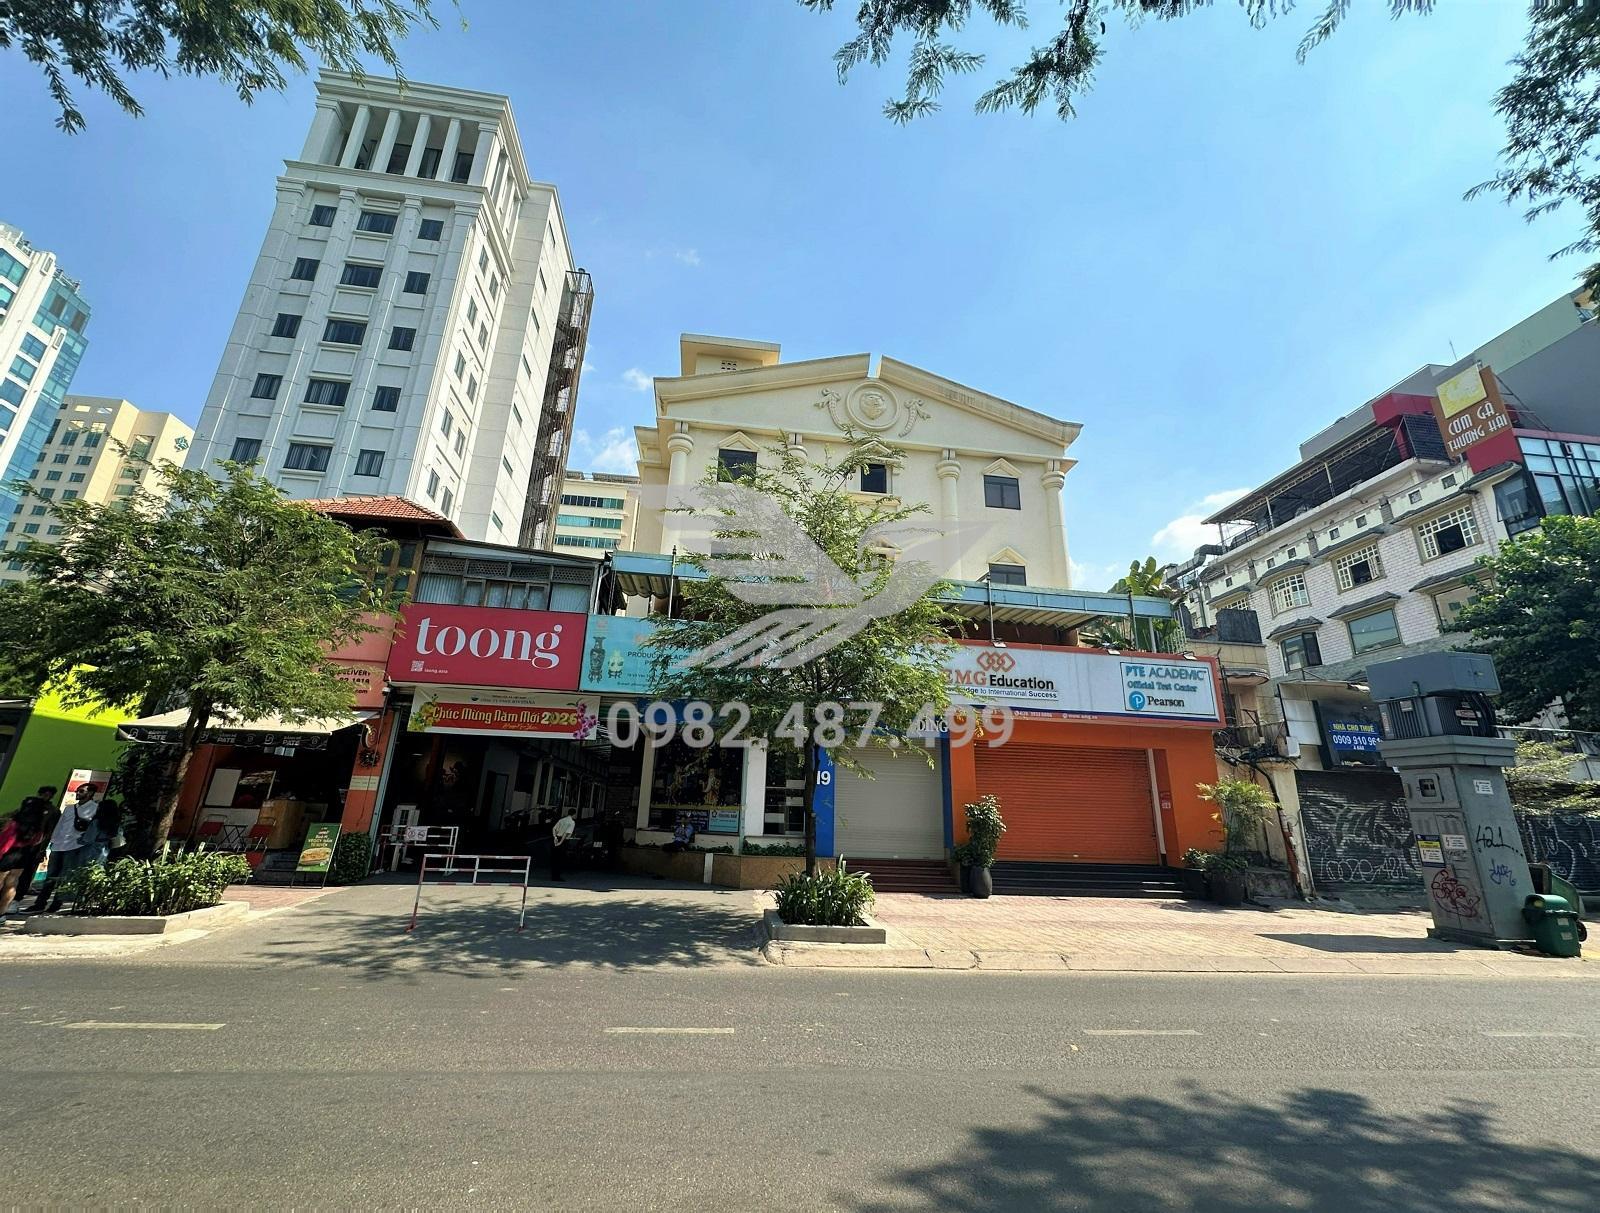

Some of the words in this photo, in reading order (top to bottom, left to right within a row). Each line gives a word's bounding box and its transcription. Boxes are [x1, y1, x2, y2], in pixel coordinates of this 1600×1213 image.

[1477, 401, 1495, 419] GÀ
[416, 617, 563, 669] toong
[1126, 665, 1146, 677] PTE
[989, 674, 1054, 690] Education
[1127, 681, 1154, 690] Official
[1156, 682, 1172, 691] Test
[1174, 683, 1198, 692] Center
[988, 689, 1028, 697] International
[1147, 695, 1185, 707] Pearson
[432, 706, 460, 720] Chúc
[461, 707, 492, 724] Mừng
[494, 709, 518, 723] Năm
[520, 710, 540, 723] Mới
[540, 711, 578, 726] 2026
[1333, 735, 1351, 744] 0909
